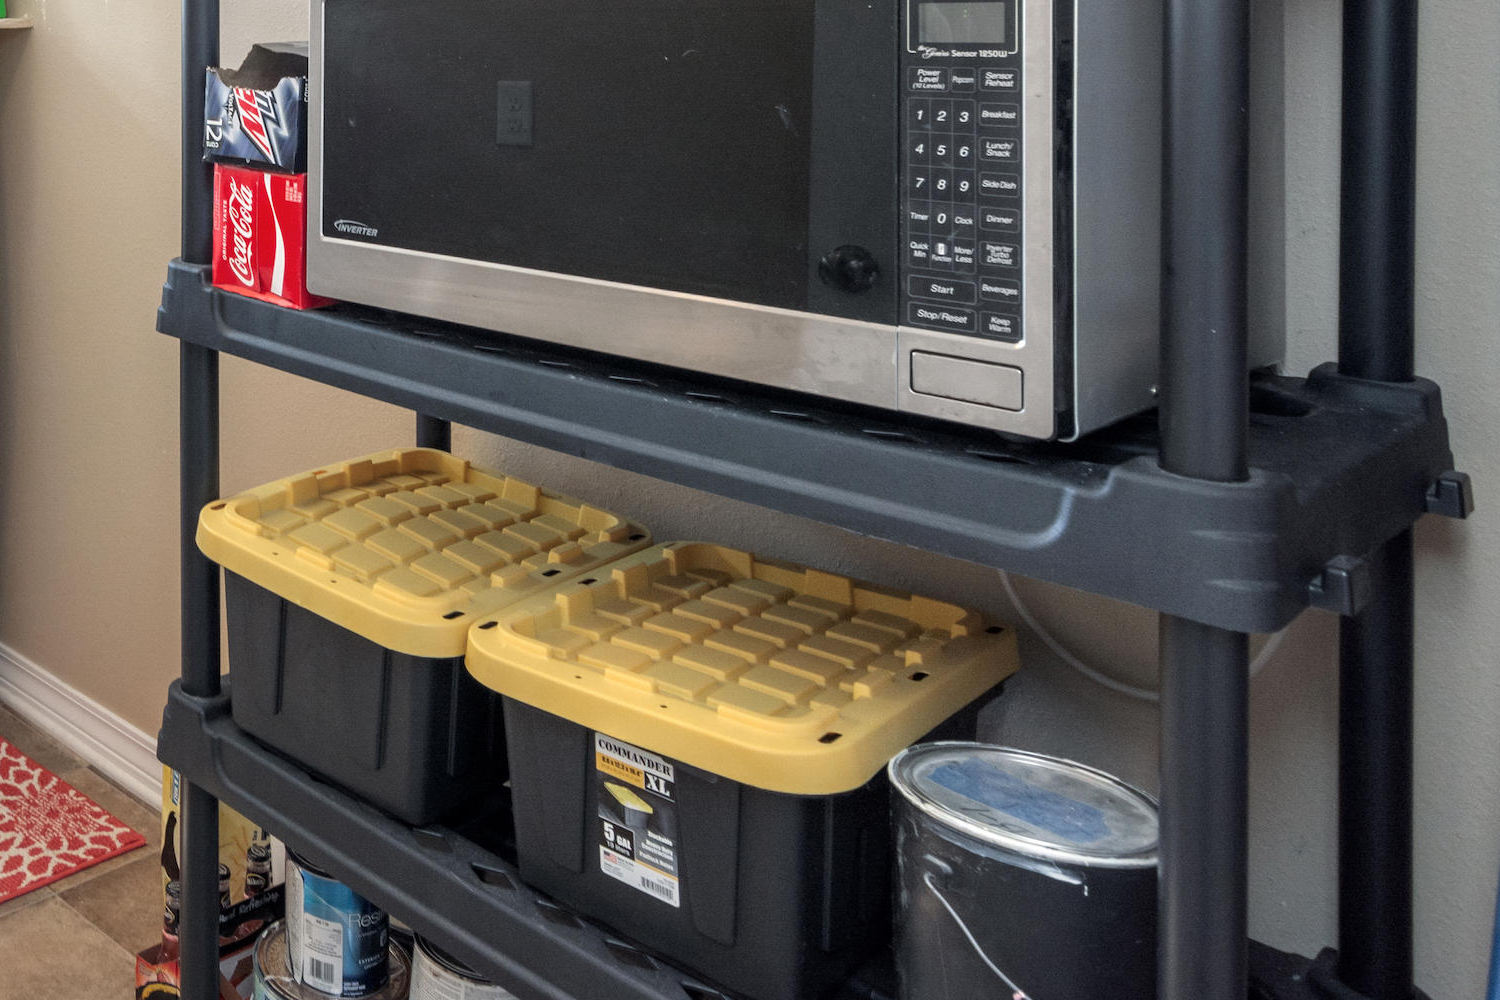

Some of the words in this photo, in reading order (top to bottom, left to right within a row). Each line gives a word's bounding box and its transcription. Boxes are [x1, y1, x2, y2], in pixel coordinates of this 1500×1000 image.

[985, 79, 1014, 87] Reheat
[916, 110, 924, 120] 1
[936, 111, 947, 122] 2
[959, 112, 969, 123] 3
[914, 143, 925, 154] 4
[936, 145, 946, 156] 5
[959, 146, 969, 157] 6
[915, 178, 924, 188] 7
[936, 179, 947, 190] 8
[959, 180, 969, 192] 9
[936, 213, 947, 224] 0
[986, 215, 1014, 224] Dinner
[338, 223, 378, 237] INVERTER
[930, 284, 954, 295] Start
[917, 308, 968, 324] Stop/Reset
[598, 739, 671, 777] COMMANDER
[645, 772, 671, 797] XL
[603, 821, 615, 842] 5
[616, 835, 632, 851] GAL
